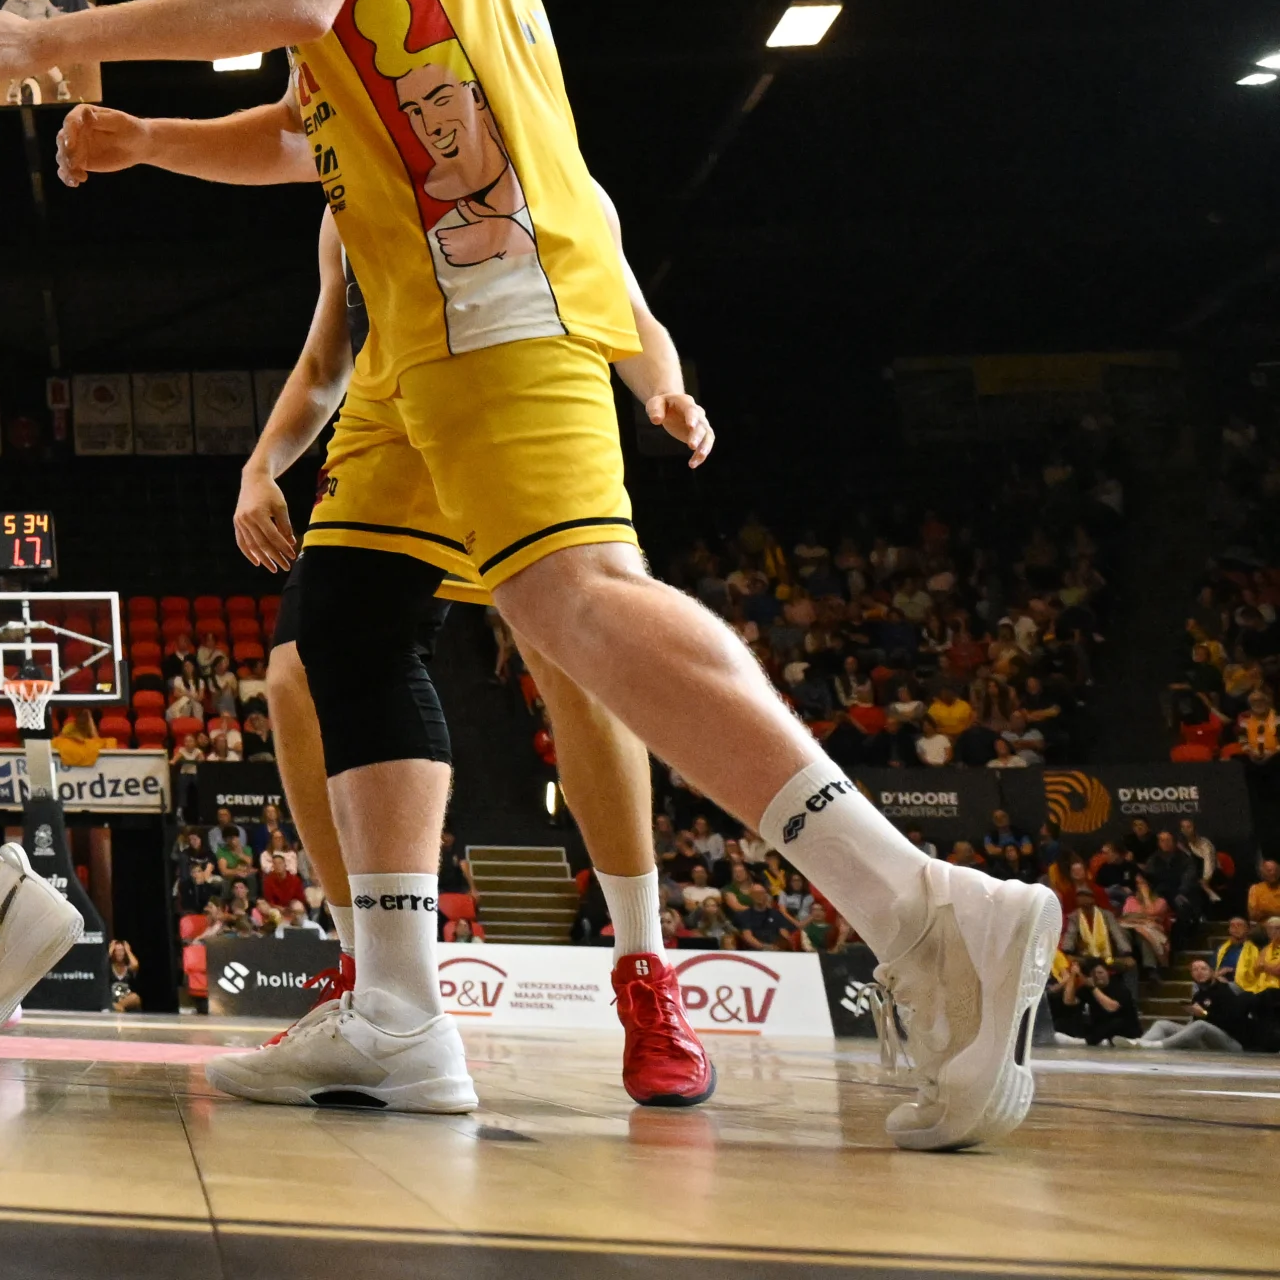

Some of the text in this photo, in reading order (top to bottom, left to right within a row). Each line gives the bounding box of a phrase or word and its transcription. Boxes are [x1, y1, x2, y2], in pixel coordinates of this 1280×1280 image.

[17, 773, 160, 801] Nordzee
[1118, 785, 1200, 802] D'HOORE
[216, 793, 282, 806] SCREW IT
[880, 791, 959, 806] D'HOORE
[884, 805, 959, 818] CONSTRUCT
[1120, 800, 1201, 815] CONSTRUCT
[440, 978, 505, 1010] P&V
[517, 981, 601, 993] VERZEKERAARS
[513, 991, 596, 1002] MAAR BOVENAL
[682, 984, 777, 1024] P&V
